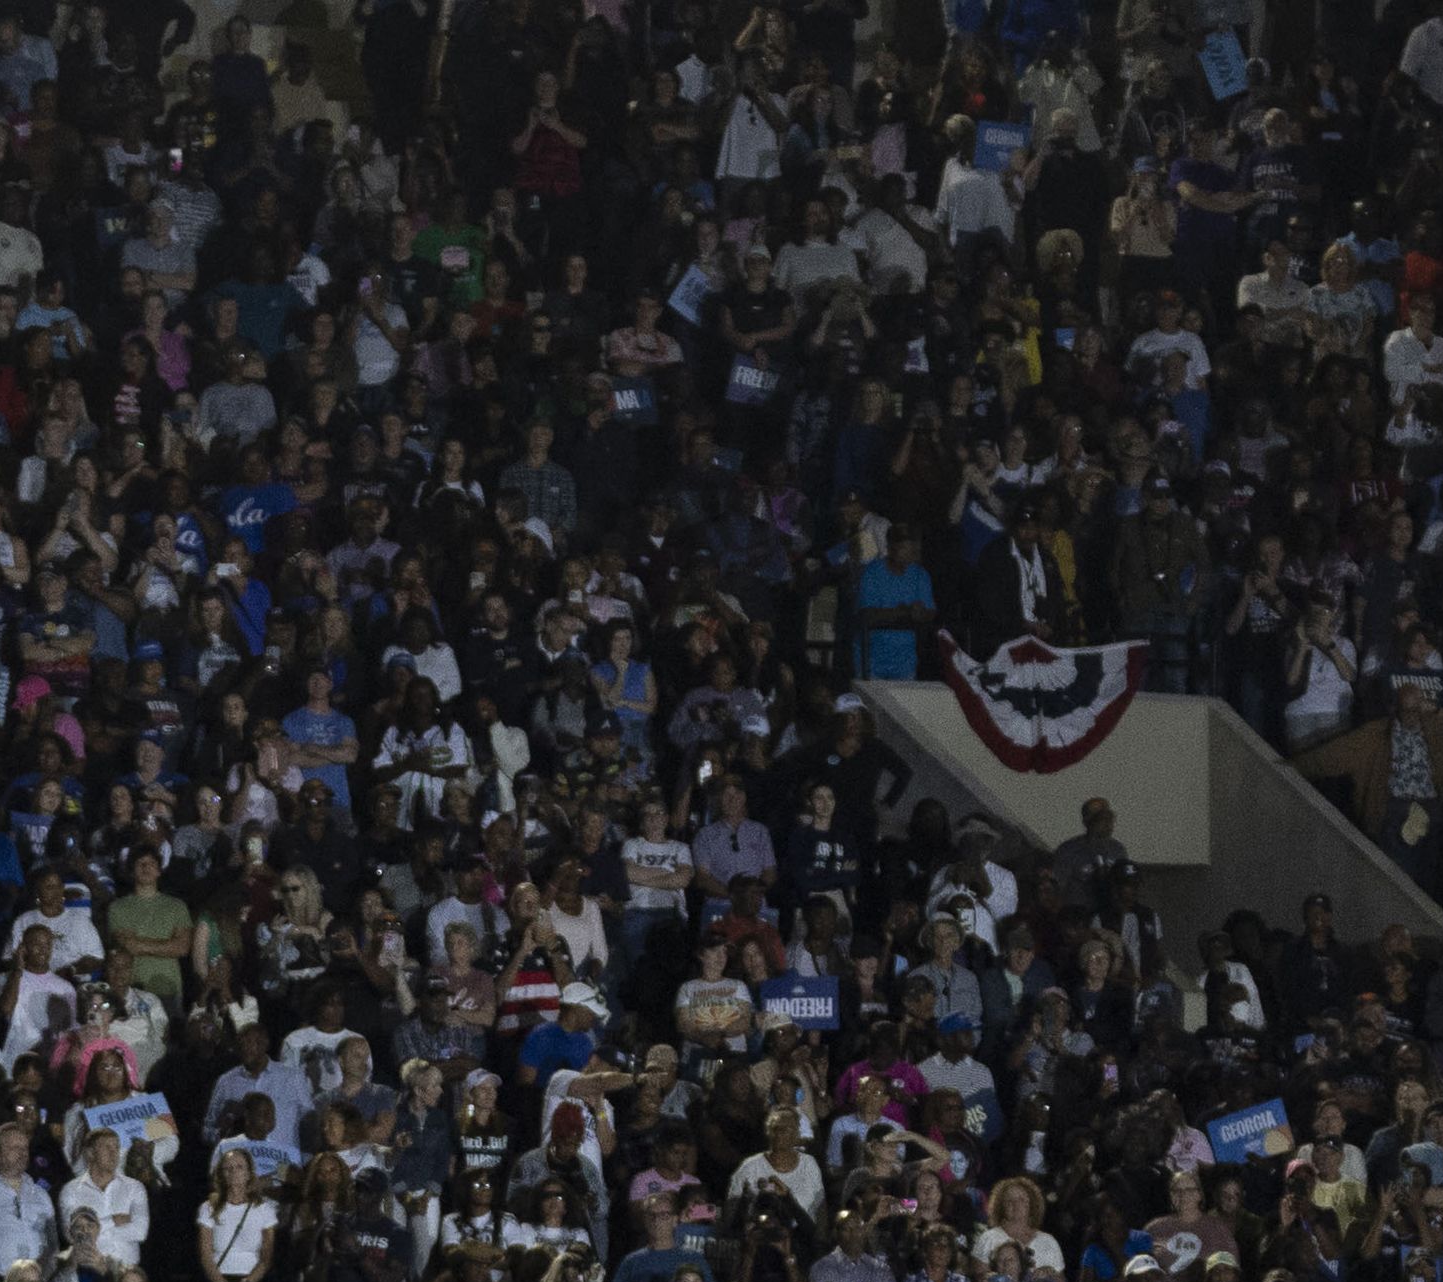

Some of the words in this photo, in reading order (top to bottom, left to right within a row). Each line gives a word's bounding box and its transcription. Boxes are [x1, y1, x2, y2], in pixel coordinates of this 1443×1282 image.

[100, 1104, 157, 1128] GEORGIA
[1219, 1111, 1277, 1143] GEORGIA
[251, 1147, 289, 1163] ORGIA
